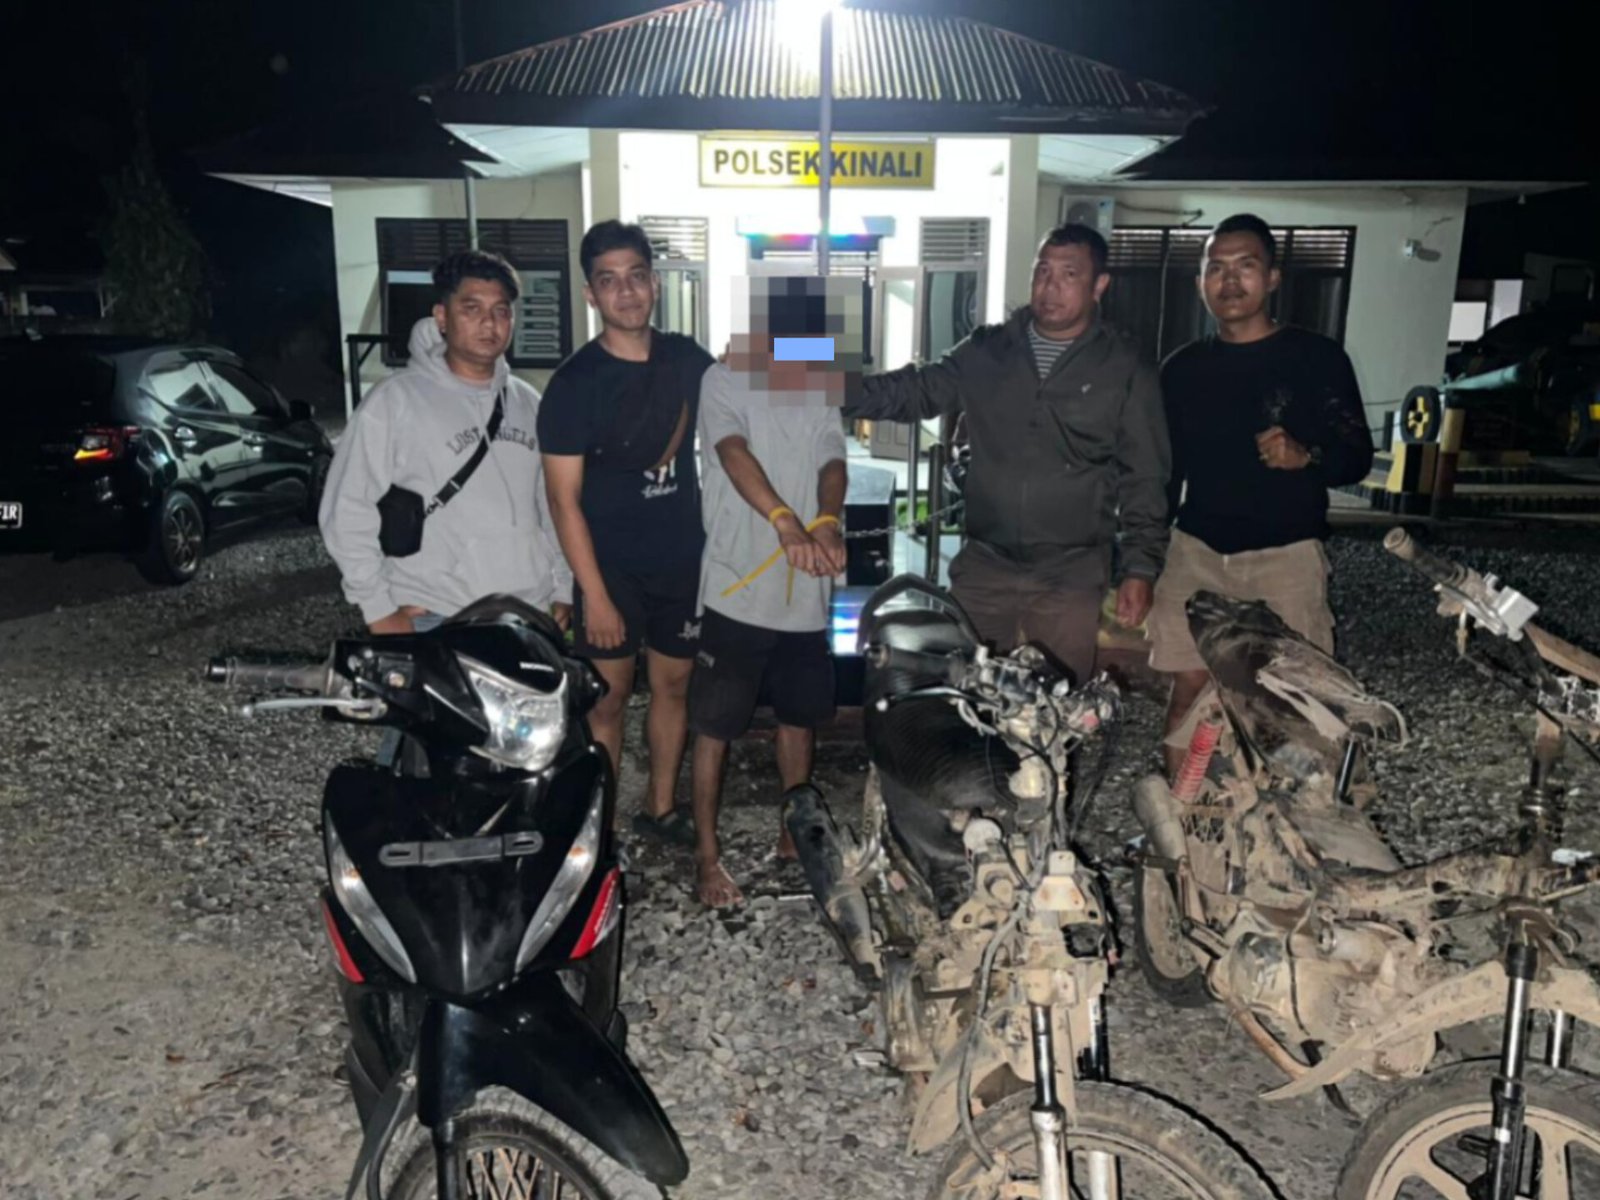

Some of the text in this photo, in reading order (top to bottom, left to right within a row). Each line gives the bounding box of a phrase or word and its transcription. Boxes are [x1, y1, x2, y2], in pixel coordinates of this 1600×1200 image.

[714, 149, 922, 177] POLSEK KINALI
[446, 426, 481, 455] LOST
